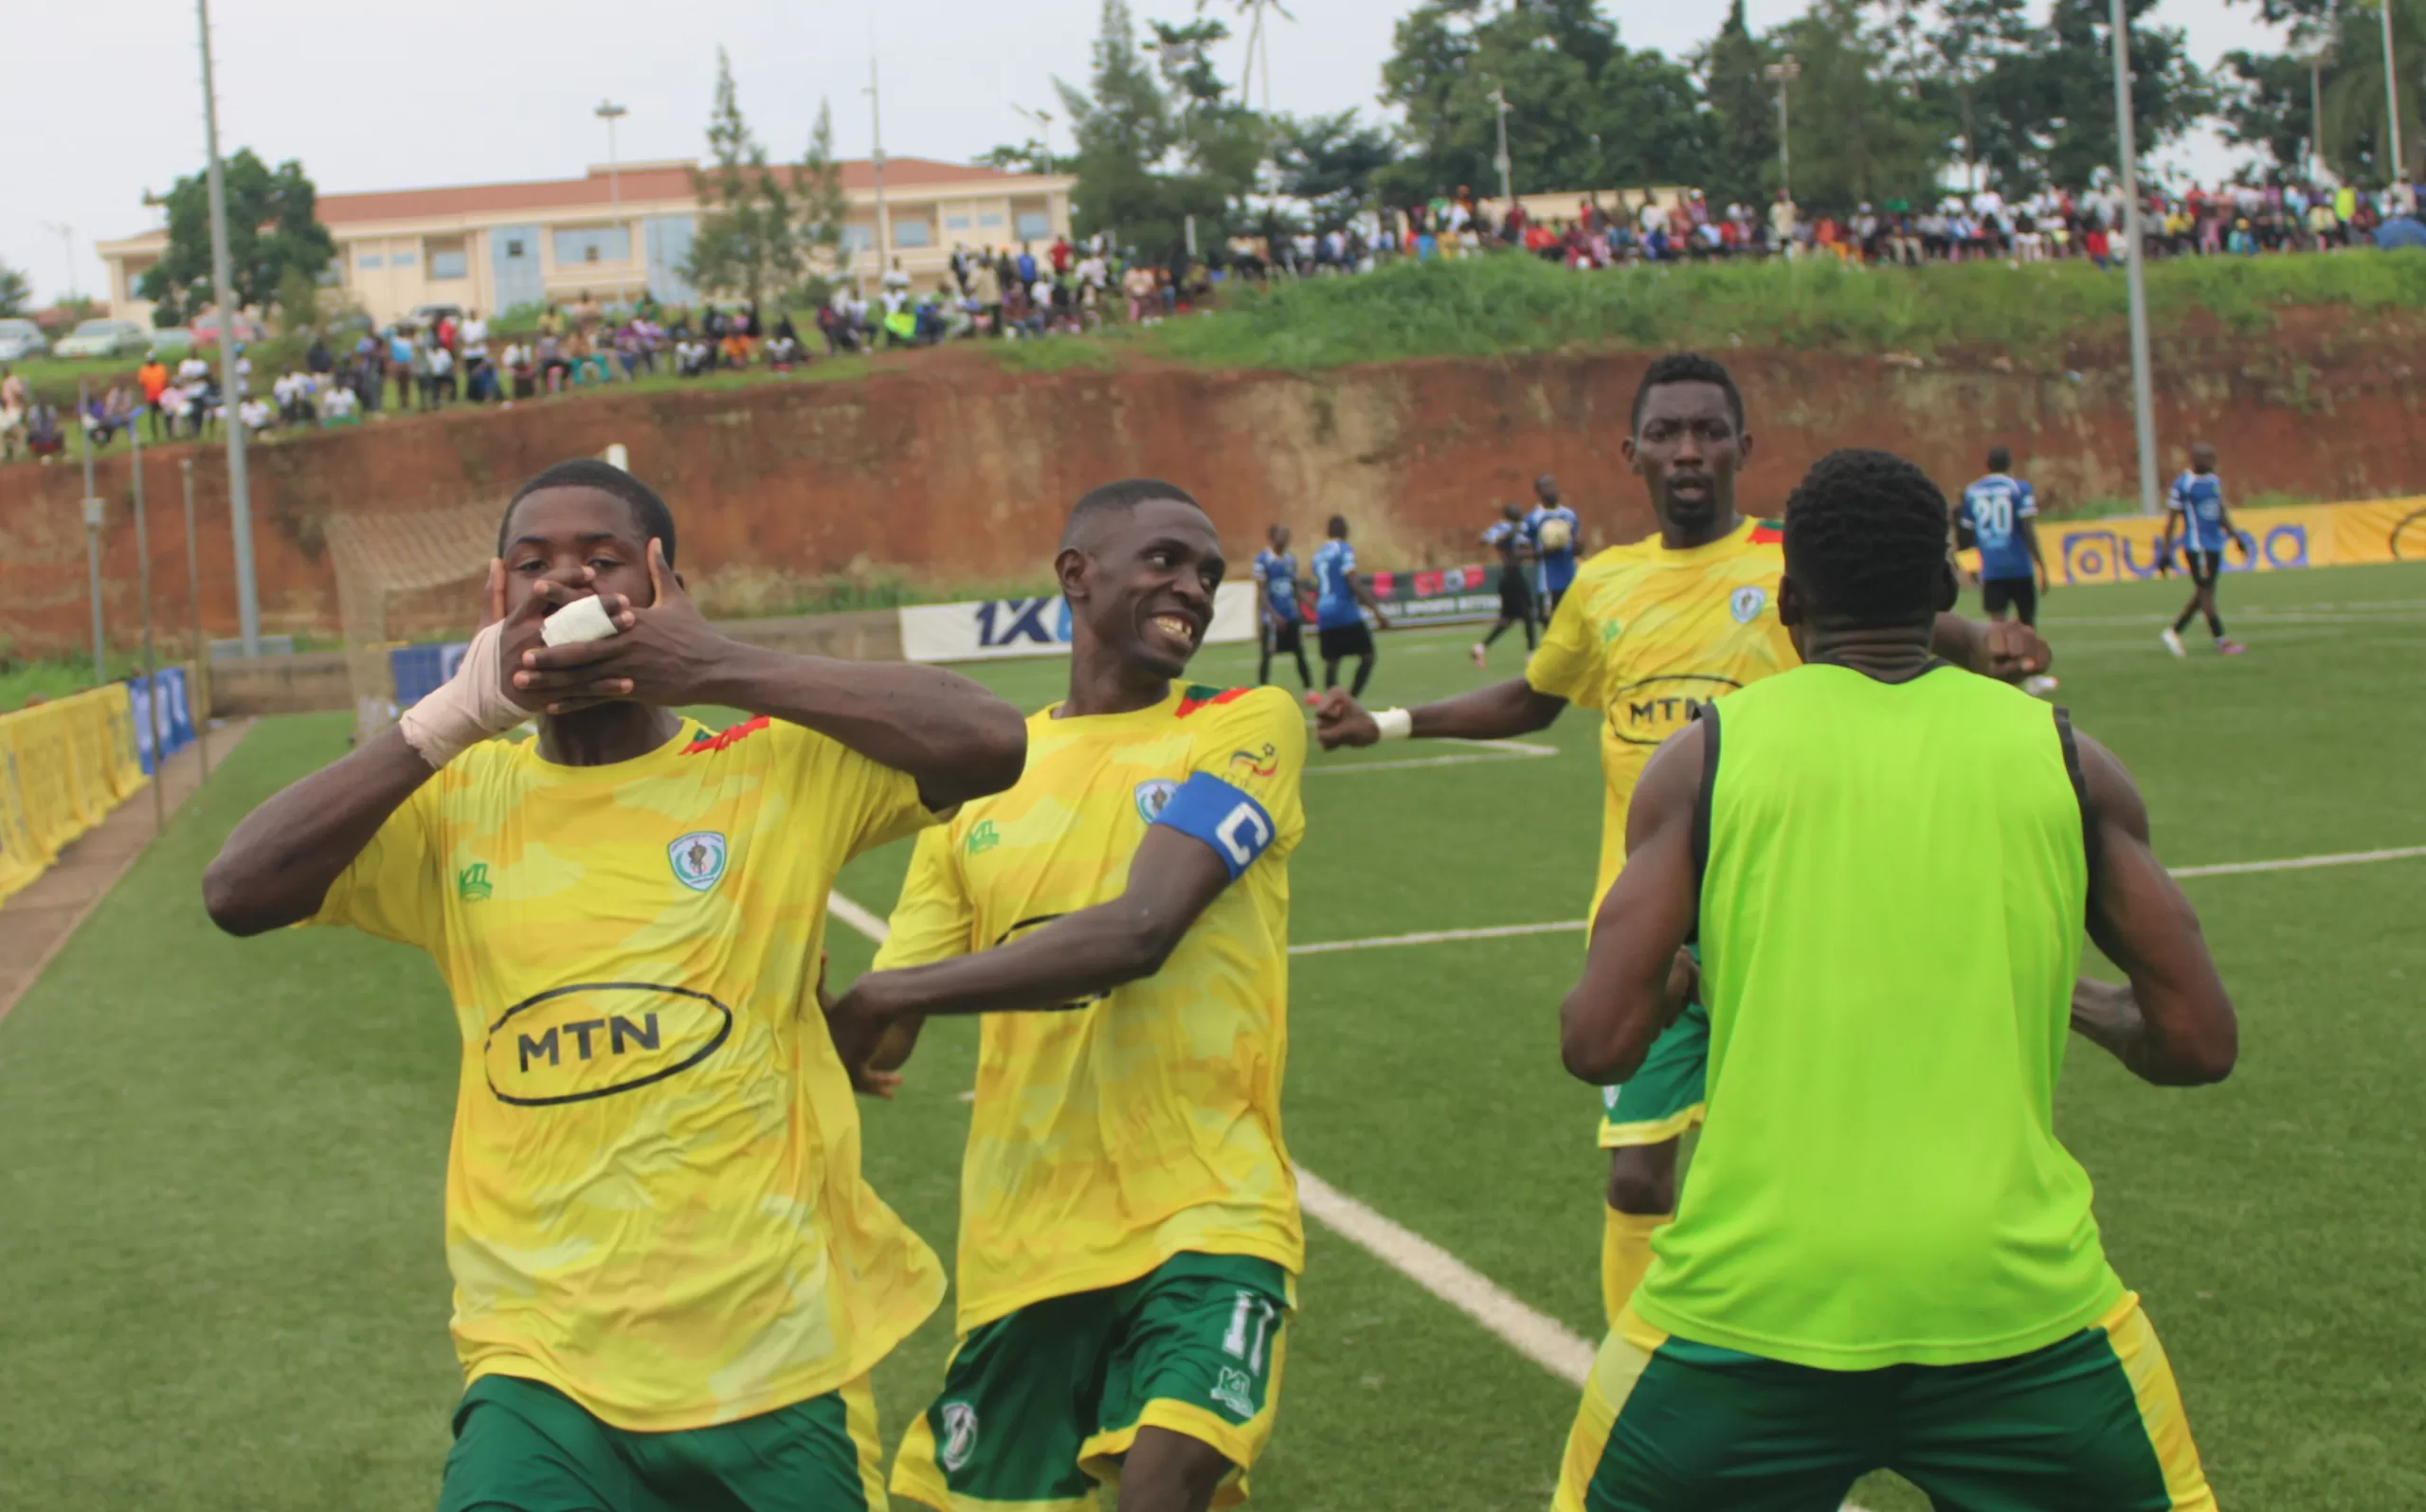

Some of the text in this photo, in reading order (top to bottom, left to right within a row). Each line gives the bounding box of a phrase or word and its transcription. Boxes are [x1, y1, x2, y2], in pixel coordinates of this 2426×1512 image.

[1973, 495, 2013, 538] 20
[1216, 801, 1269, 865] C
[516, 1012, 661, 1073] MTN
